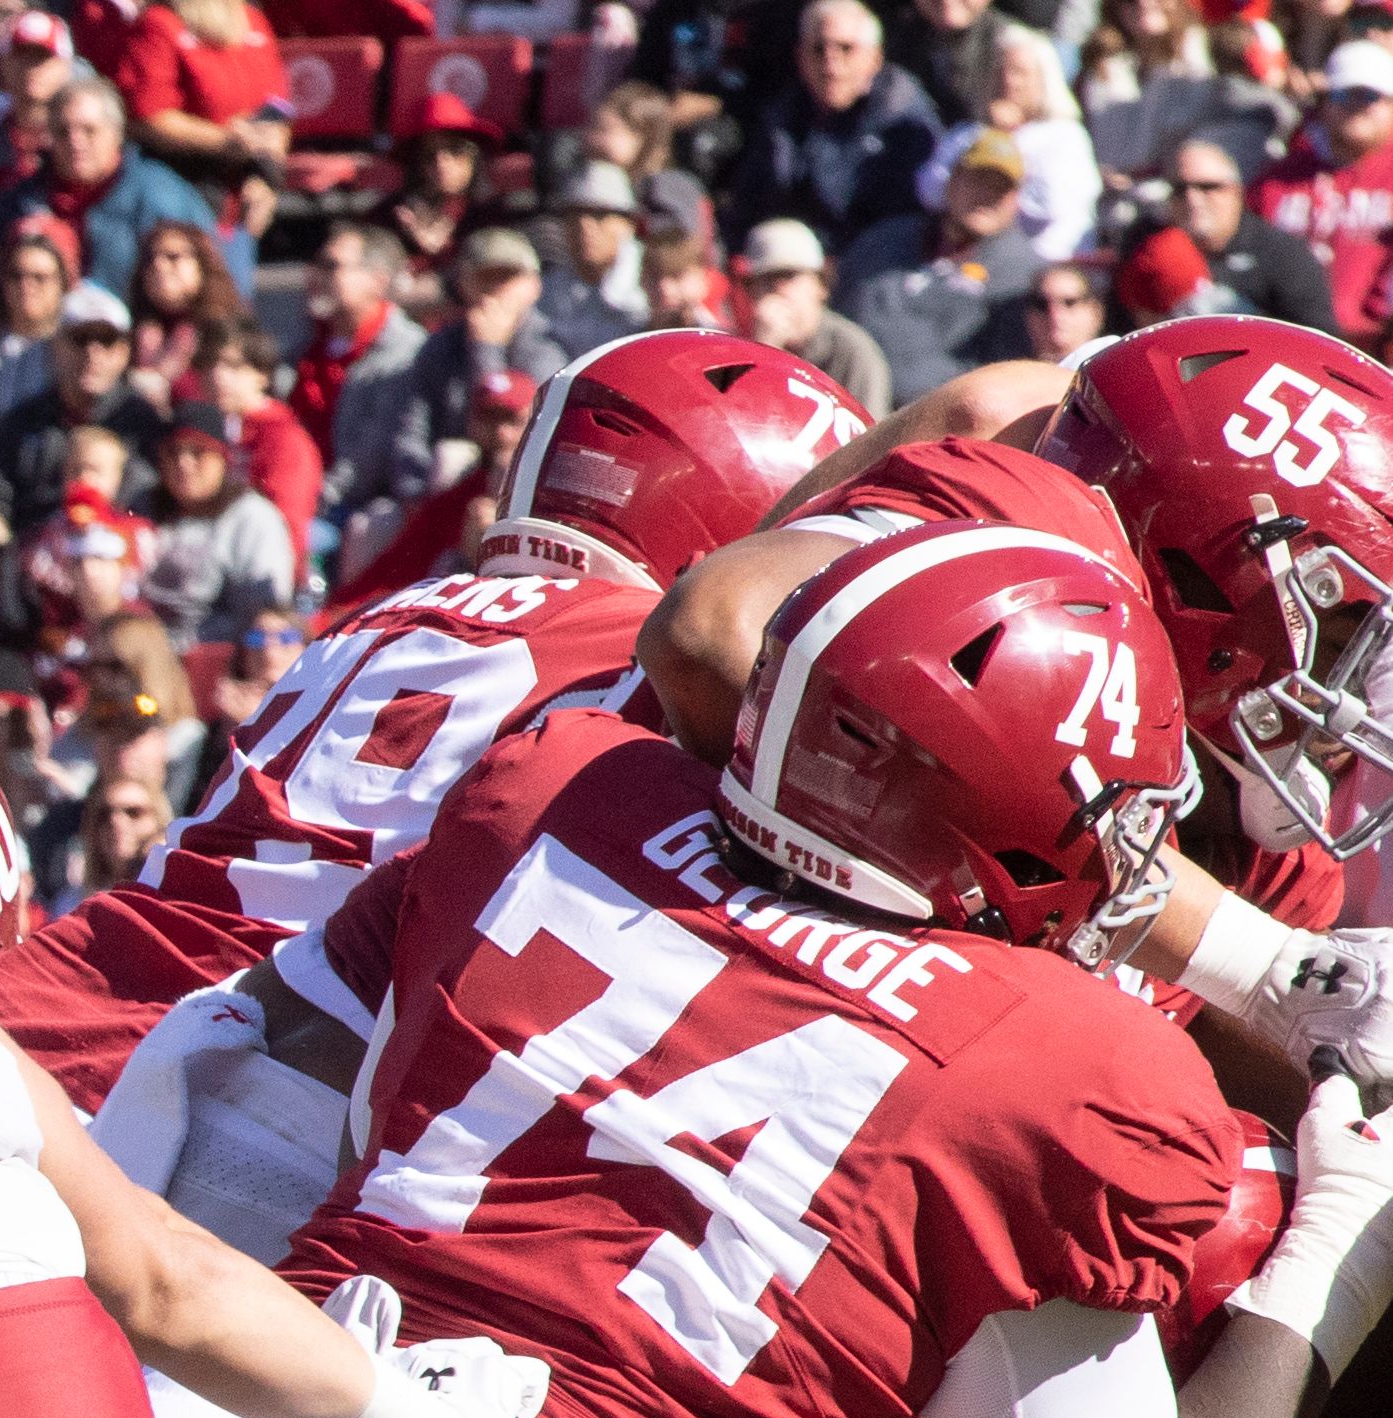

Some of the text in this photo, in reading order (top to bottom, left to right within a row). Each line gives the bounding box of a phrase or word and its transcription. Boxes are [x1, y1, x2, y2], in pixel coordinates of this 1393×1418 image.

[1222, 362, 1367, 488] 55
[1055, 631, 1140, 758] 74
[784, 840, 853, 891] TIDE
[354, 833, 909, 1385] 74
